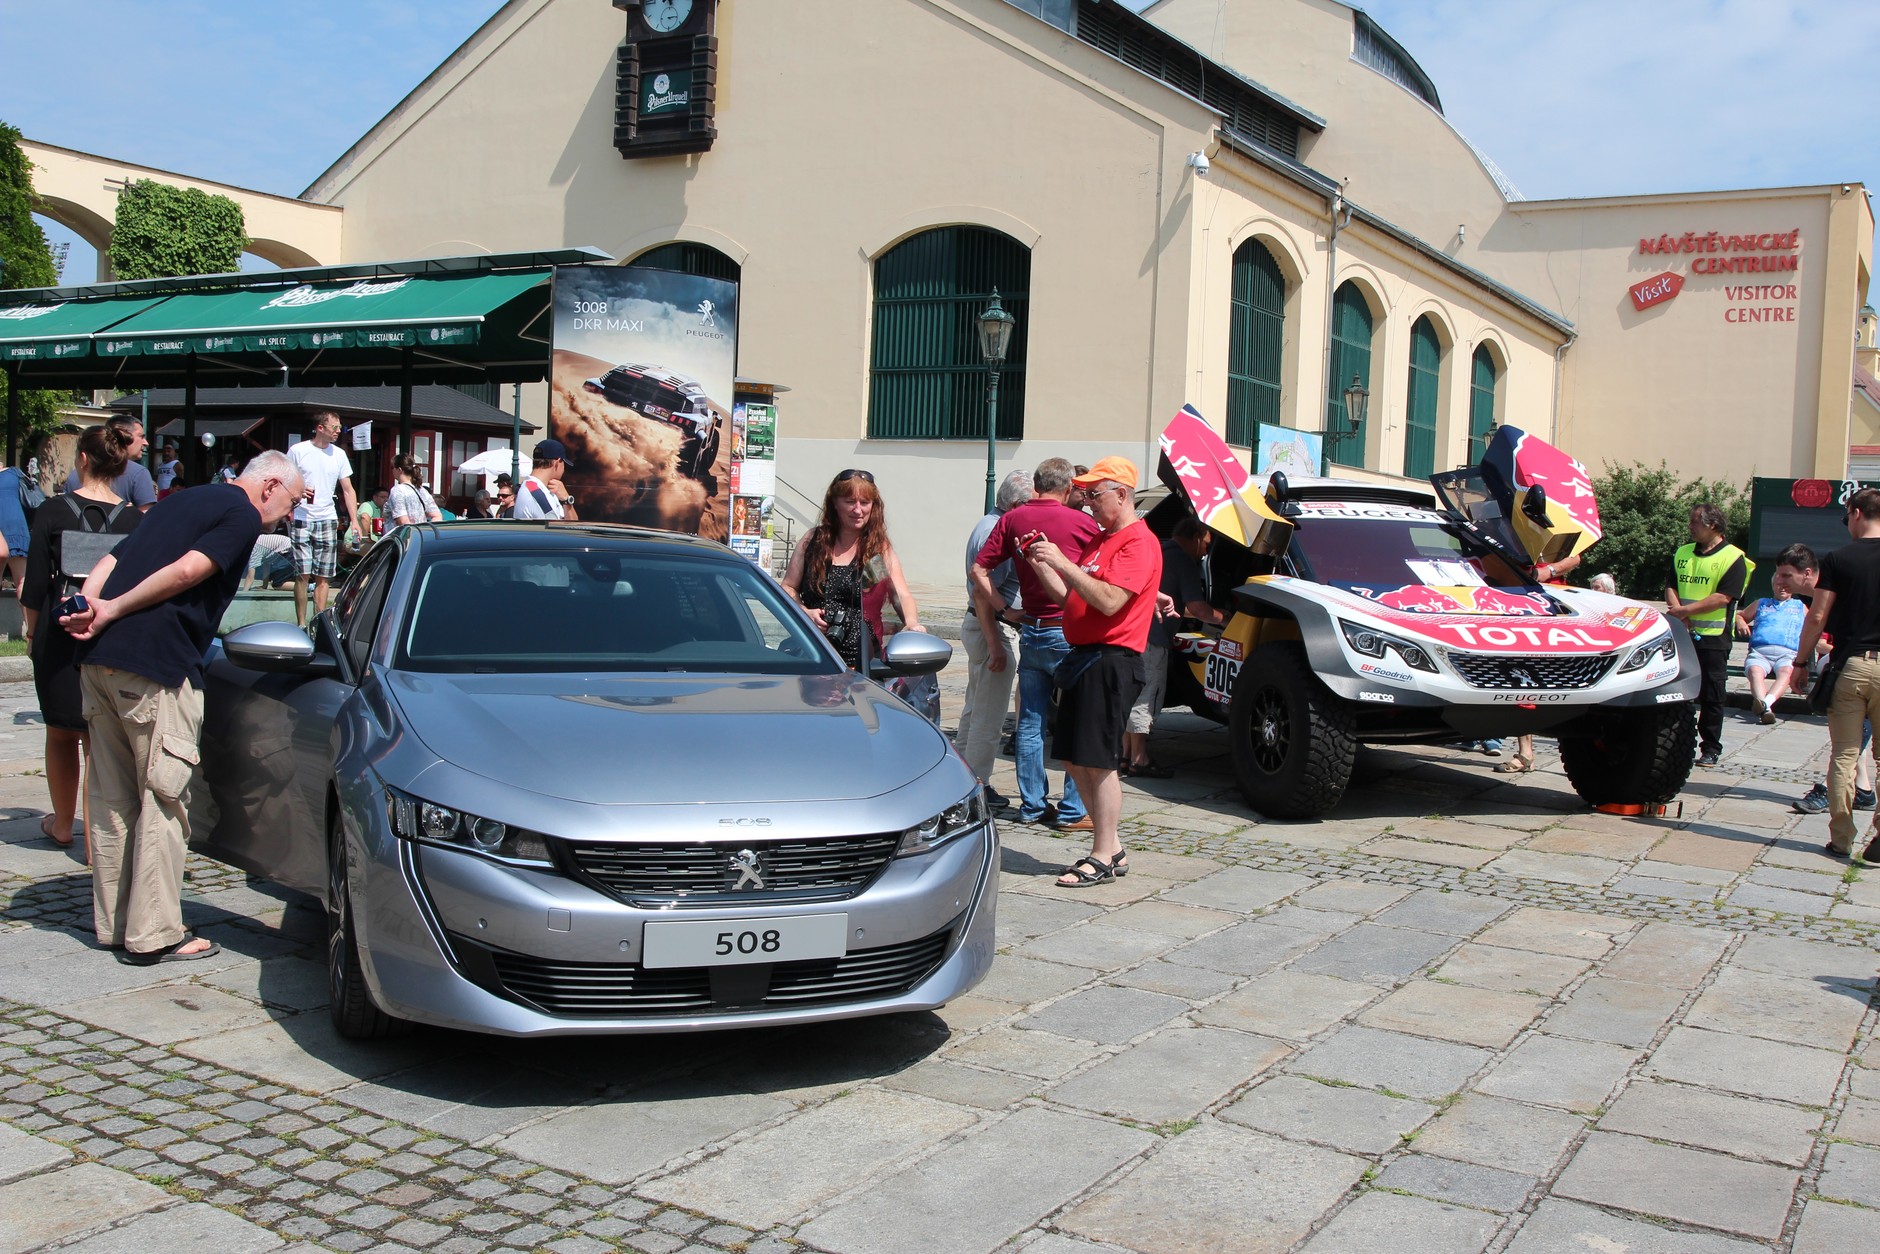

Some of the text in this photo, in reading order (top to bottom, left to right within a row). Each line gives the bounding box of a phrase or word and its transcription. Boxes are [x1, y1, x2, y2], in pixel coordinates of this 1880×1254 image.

[1639, 228, 1800, 254] NÁVŠTĚVNICKÉ
[1691, 255, 1798, 274] CENTRUM
[1634, 277, 1671, 304] Visit
[1725, 285, 1797, 300] VISITOR
[573, 301, 607, 314] 3008
[1724, 307, 1795, 322] CENTRE
[573, 318, 644, 332] DKR MAXI
[369, 333, 405, 342] RESTAURACE
[686, 329, 725, 340] PEUGEOT
[153, 342, 184, 351] RESTAURACE
[1679, 574, 1710, 585] SECURITY
[1439, 623, 1614, 646] TOTAL
[1206, 654, 1238, 696] 306
[1360, 664, 1413, 682] BFGoodrich
[1359, 691, 1394, 703] sparco
[1493, 694, 1570, 702] PEUGEOT
[1655, 692, 1684, 703] sparco
[718, 817, 773, 827] 508
[715, 929, 781, 956] 508
